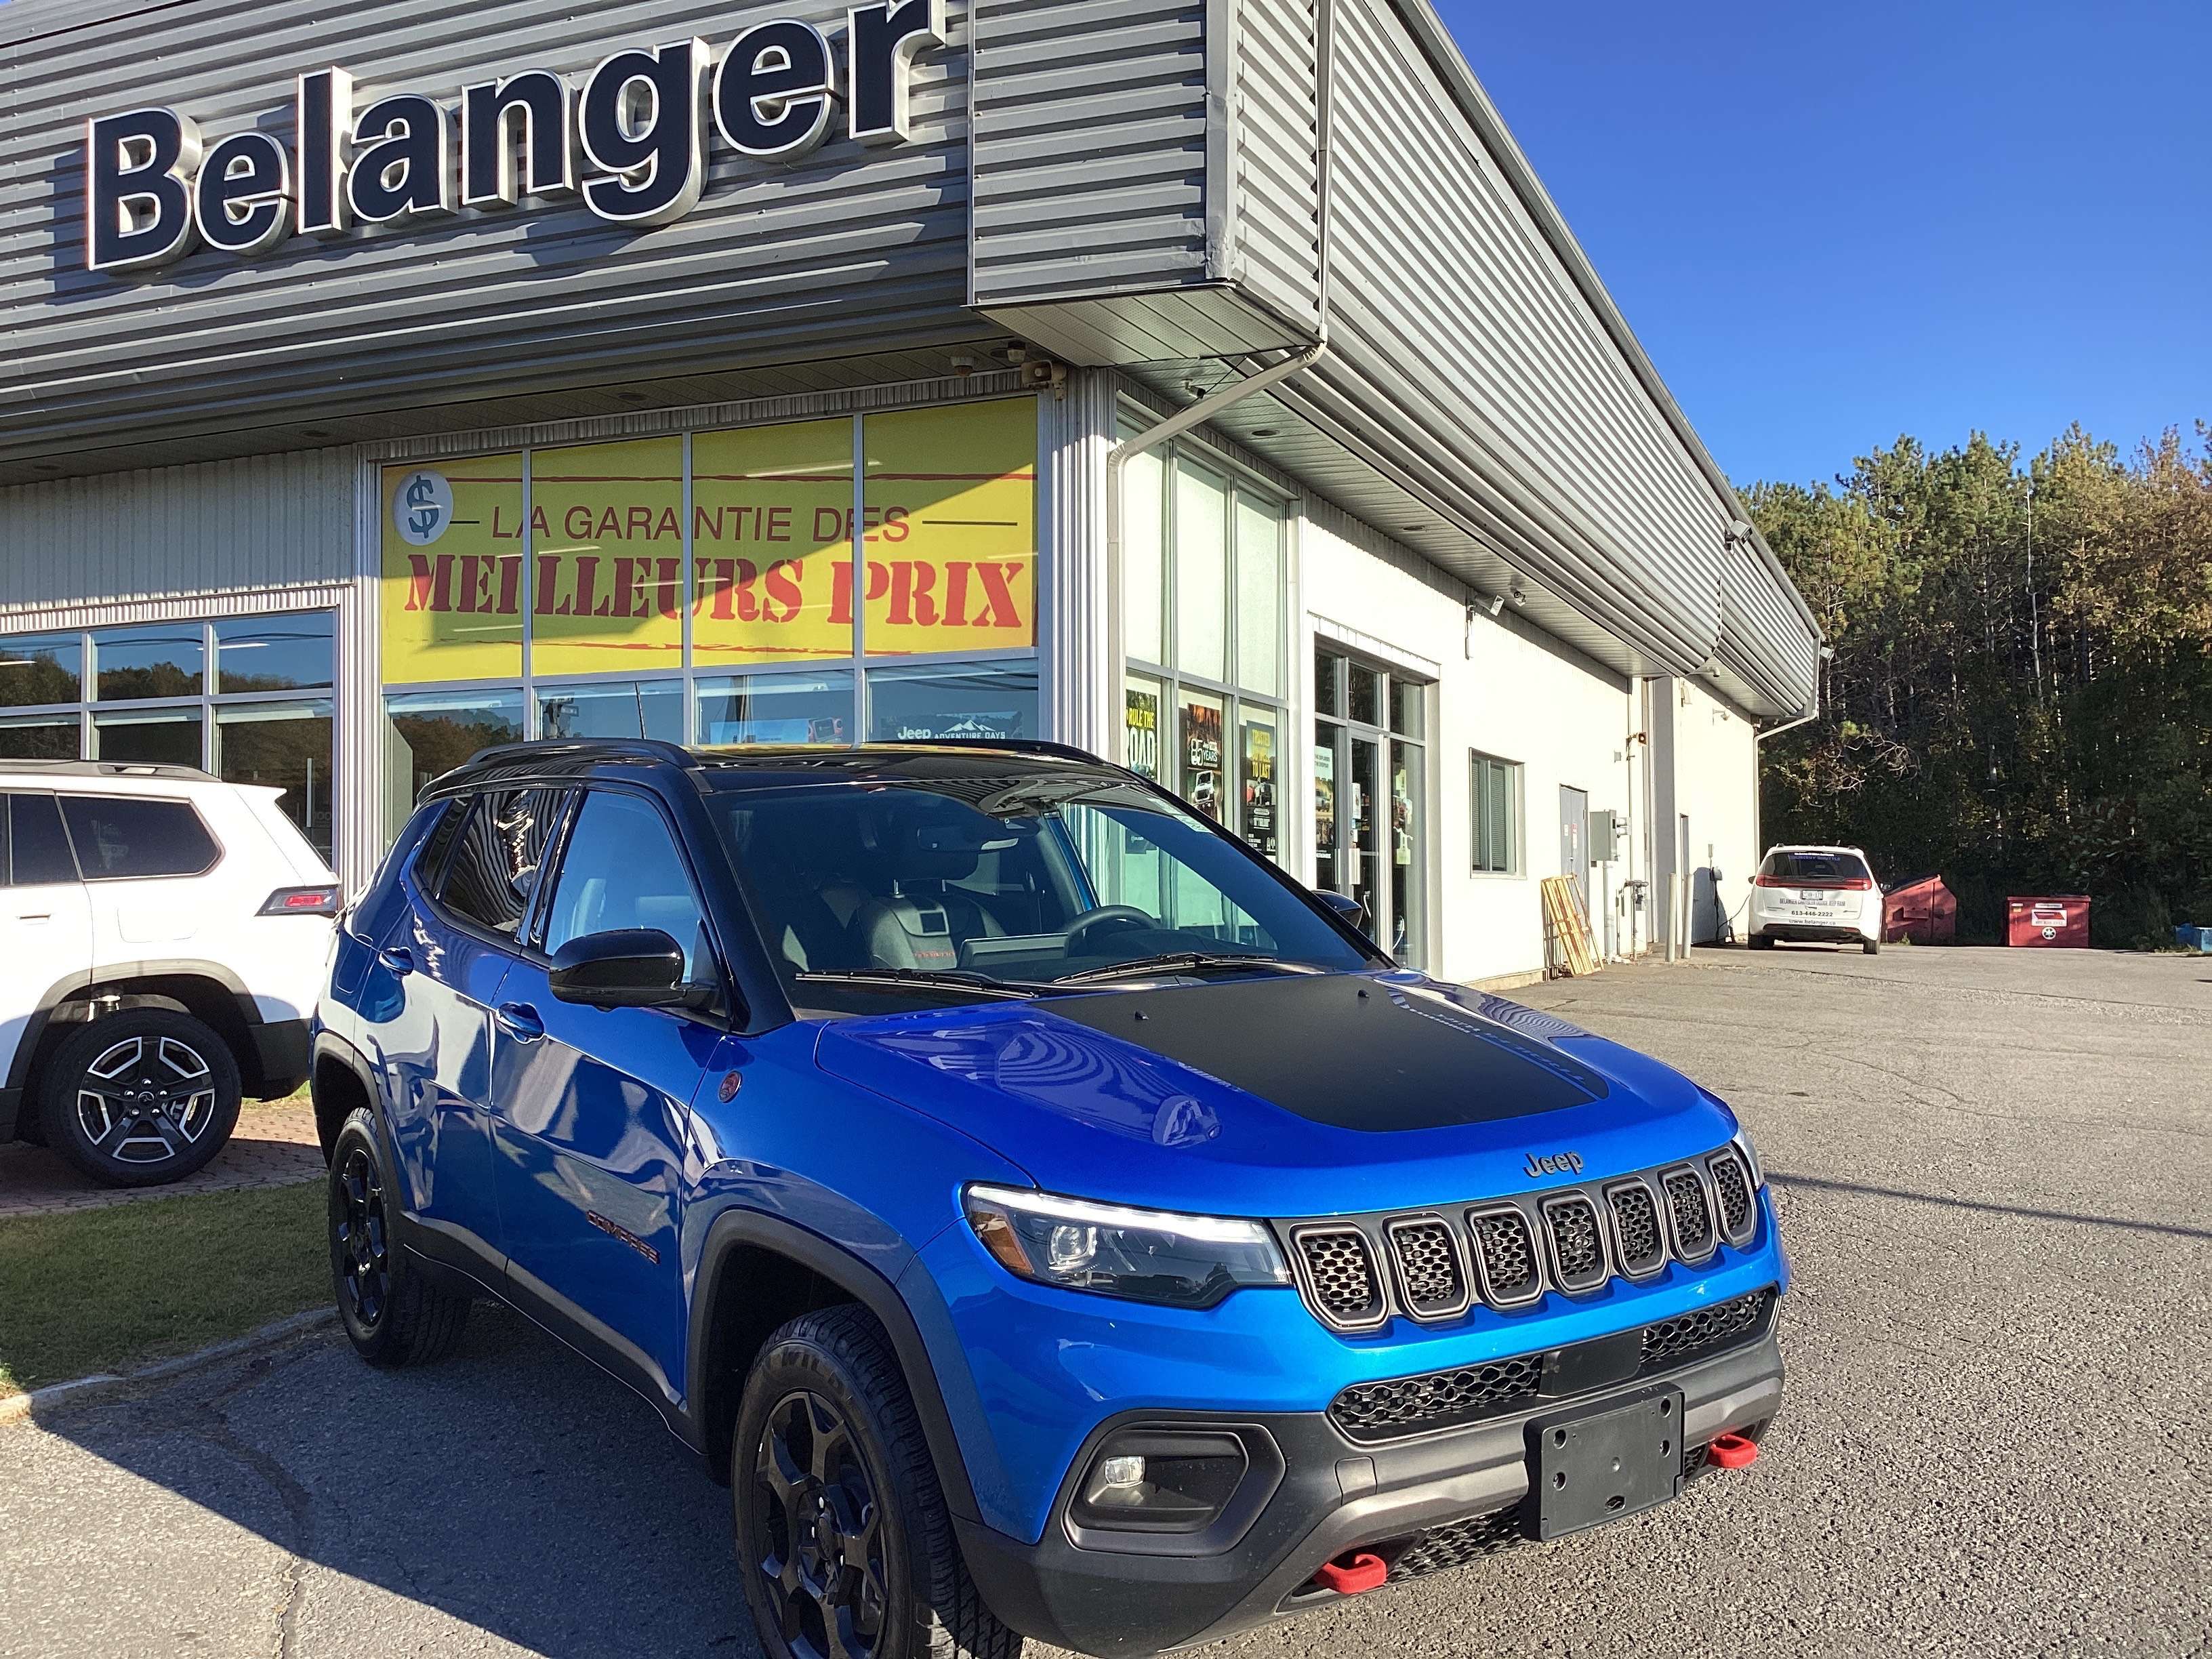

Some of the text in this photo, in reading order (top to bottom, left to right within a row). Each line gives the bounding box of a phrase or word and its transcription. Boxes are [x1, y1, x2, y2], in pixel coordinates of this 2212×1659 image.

[87, 0, 945, 272] Belanger
[492, 506, 910, 542] LA GARANTIE DES
[405, 554, 1024, 628] MEILLEURS PRIX
[1129, 708, 1155, 729] RULE THE
[897, 726, 1006, 739] Jeep ADVENTURE DAYS
[1191, 738, 1203, 766] 85
[1203, 750, 1218, 762] YEARS
[1523, 1151, 1584, 1178] Jeep
